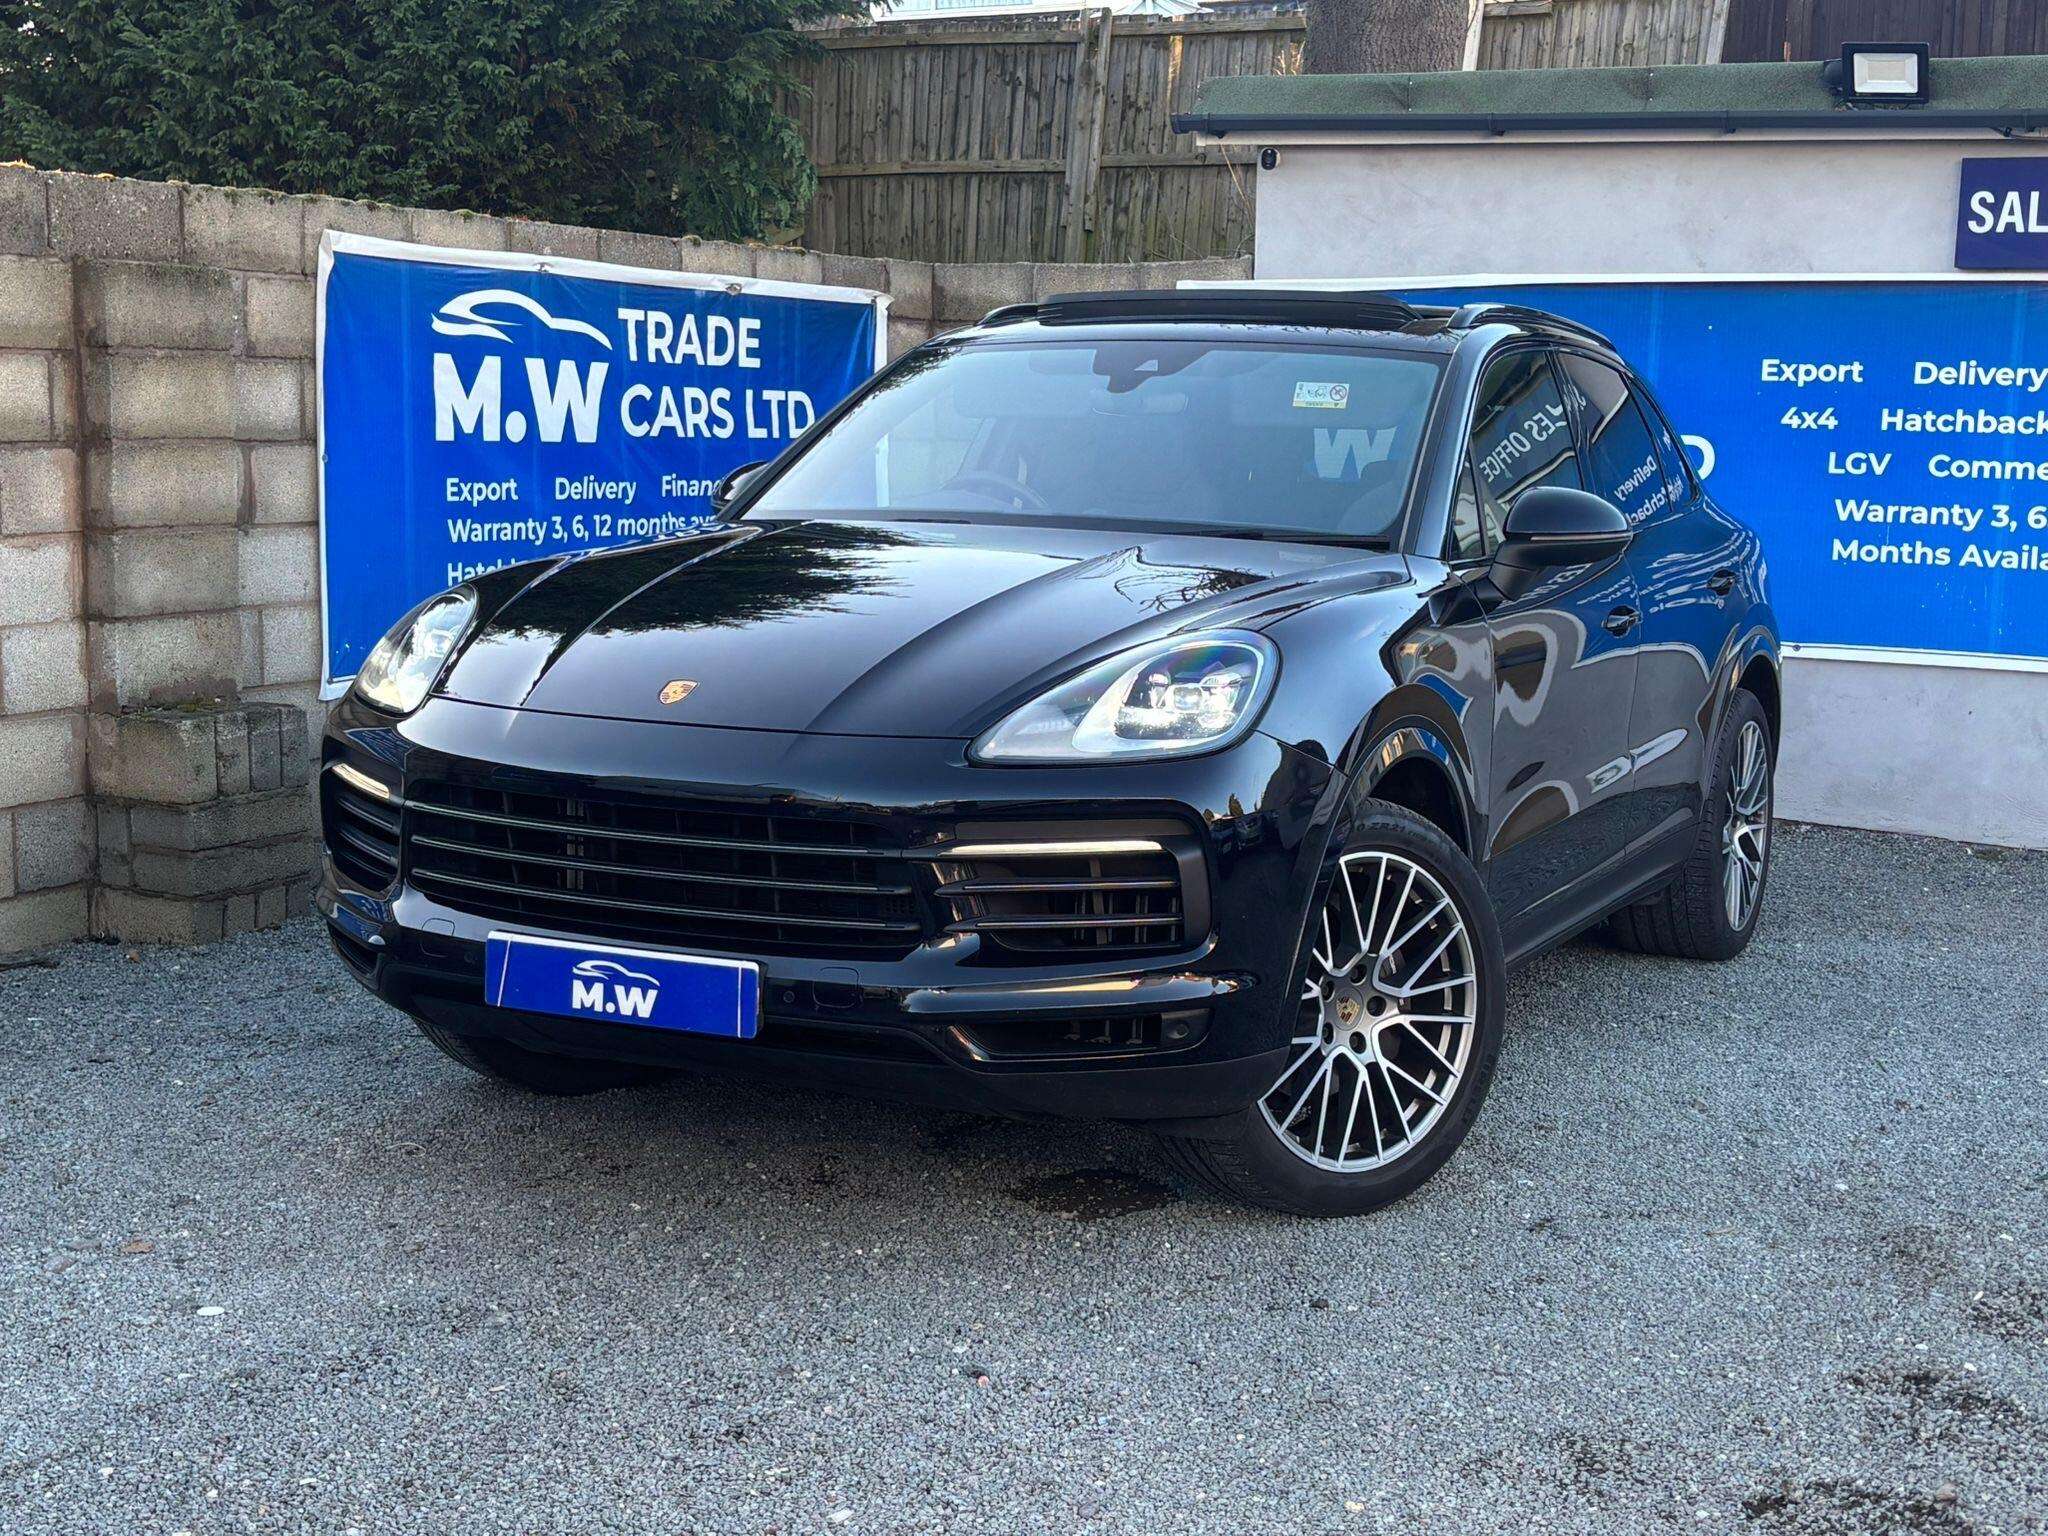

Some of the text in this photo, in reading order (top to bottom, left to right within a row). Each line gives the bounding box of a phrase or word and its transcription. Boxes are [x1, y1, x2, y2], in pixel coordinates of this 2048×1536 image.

[1967, 191, 2048, 234] SAL
[618, 307, 762, 368] TRADE
[1761, 358, 2048, 392] Export Delivery
[433, 352, 610, 443] M.W
[620, 383, 815, 440] CARS LTD
[1780, 406, 2048, 435] 4x4 Hatchback
[1828, 450, 1893, 476] LGV
[446, 477, 519, 507] Export
[555, 475, 637, 505] Delivery
[447, 517, 548, 546] Warranty
[551, 516, 568, 541] 3,
[572, 514, 589, 541] 6,
[593, 513, 612, 538] 12
[1834, 498, 1984, 532] Warranty
[1990, 504, 2018, 533] 3,
[1831, 538, 1952, 566] Months
[571, 979, 659, 1018] M.W
